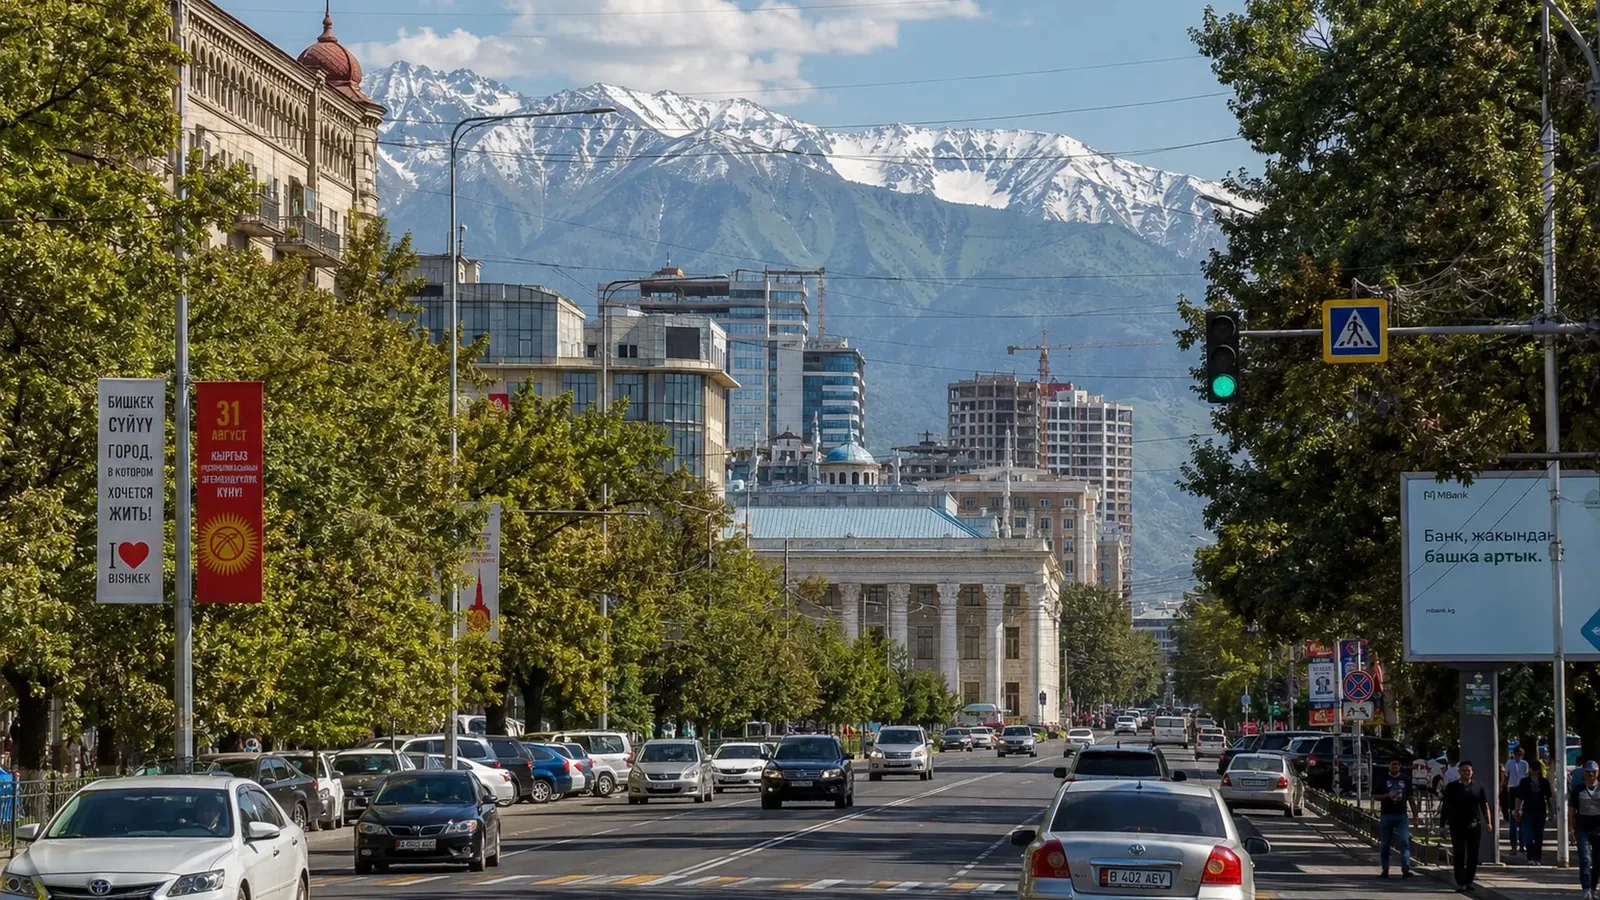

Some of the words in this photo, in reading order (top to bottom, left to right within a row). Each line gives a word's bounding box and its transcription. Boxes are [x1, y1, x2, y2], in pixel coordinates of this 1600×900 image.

[108, 395, 154, 409] БИШКЕК
[216, 400, 240, 427] 31
[108, 443, 153, 461] ГОРОД,
[211, 450, 248, 461] КЫРГЫЗ
[107, 467, 114, 477] В
[115, 467, 153, 477] КОТОРОМ
[107, 486, 153, 499] ХОЧЕТСЯ
[1437, 491, 1468, 499] MBank
[109, 506, 152, 521] ЖИТЬ!
[1424, 529, 1468, 544] Банк,
[108, 542, 117, 569] I
[1424, 550, 1479, 563] башка
[1483, 552, 1542, 566] артык.
[108, 573, 151, 584] BISHKEK
[1110, 871, 1117, 882] B
[1122, 872, 1141, 883] 402
[1146, 873, 1166, 884] AEV
